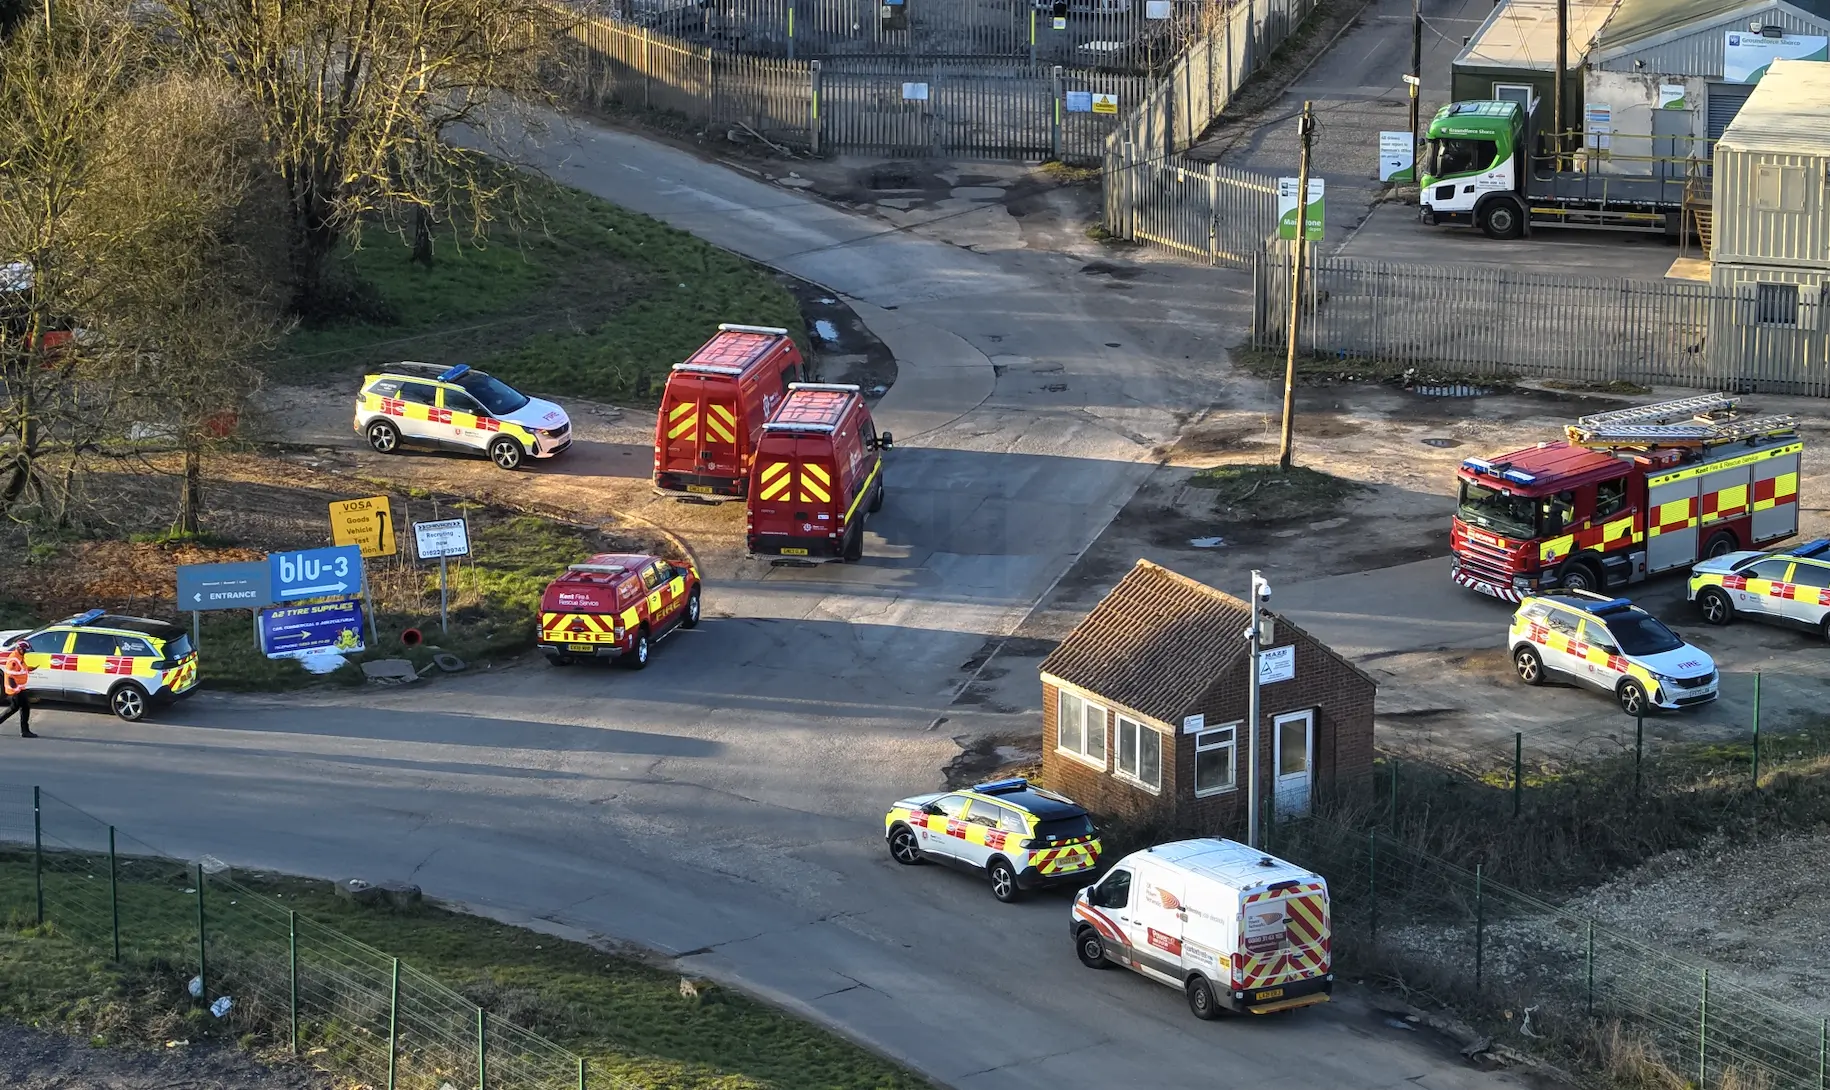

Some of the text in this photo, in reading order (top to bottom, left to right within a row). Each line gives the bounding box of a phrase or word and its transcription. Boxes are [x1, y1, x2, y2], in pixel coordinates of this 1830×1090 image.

[1724, 460, 1740, 468] Rescue
[343, 500, 372, 511] VOSA
[346, 516, 370, 524] Goods
[346, 526, 373, 534] Vehicle
[426, 531, 454, 539] Recruiting
[280, 554, 348, 583] blu-3
[209, 590, 257, 600] ENTRANCE
[271, 602, 354, 619] A2 TYRE SUPPLIES
[656, 600, 681, 621] FIRE
[545, 631, 613, 642] FIRE
[1677, 660, 1701, 670] FIRE
